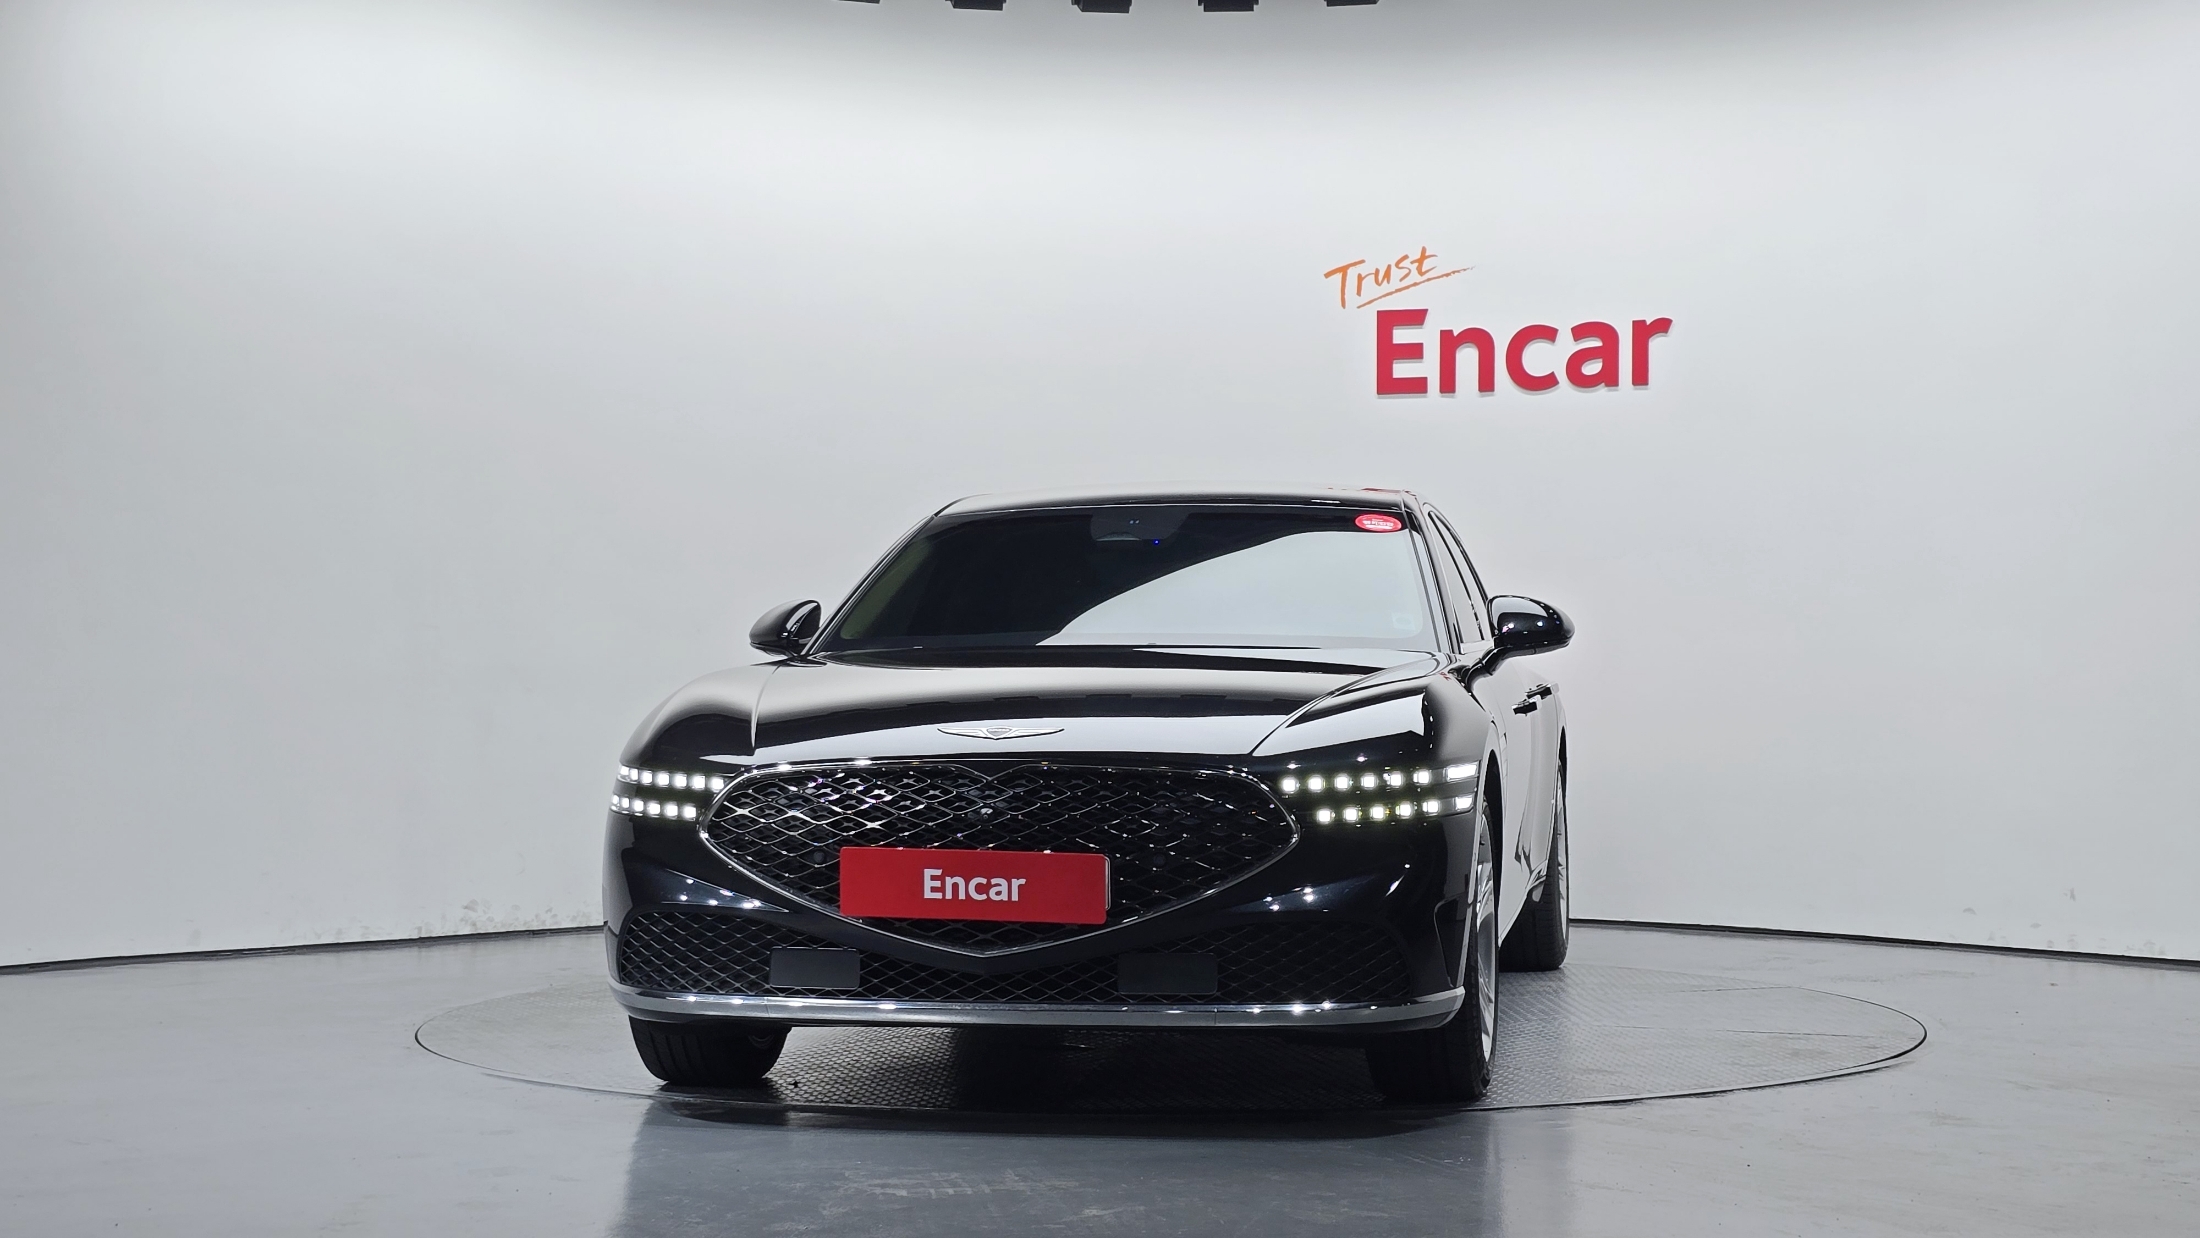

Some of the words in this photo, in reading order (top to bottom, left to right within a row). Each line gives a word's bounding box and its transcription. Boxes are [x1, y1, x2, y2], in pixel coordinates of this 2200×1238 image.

[1324, 246, 1438, 309] Trust
[1376, 308, 1673, 395] Encar
[922, 868, 1027, 902] Encar
